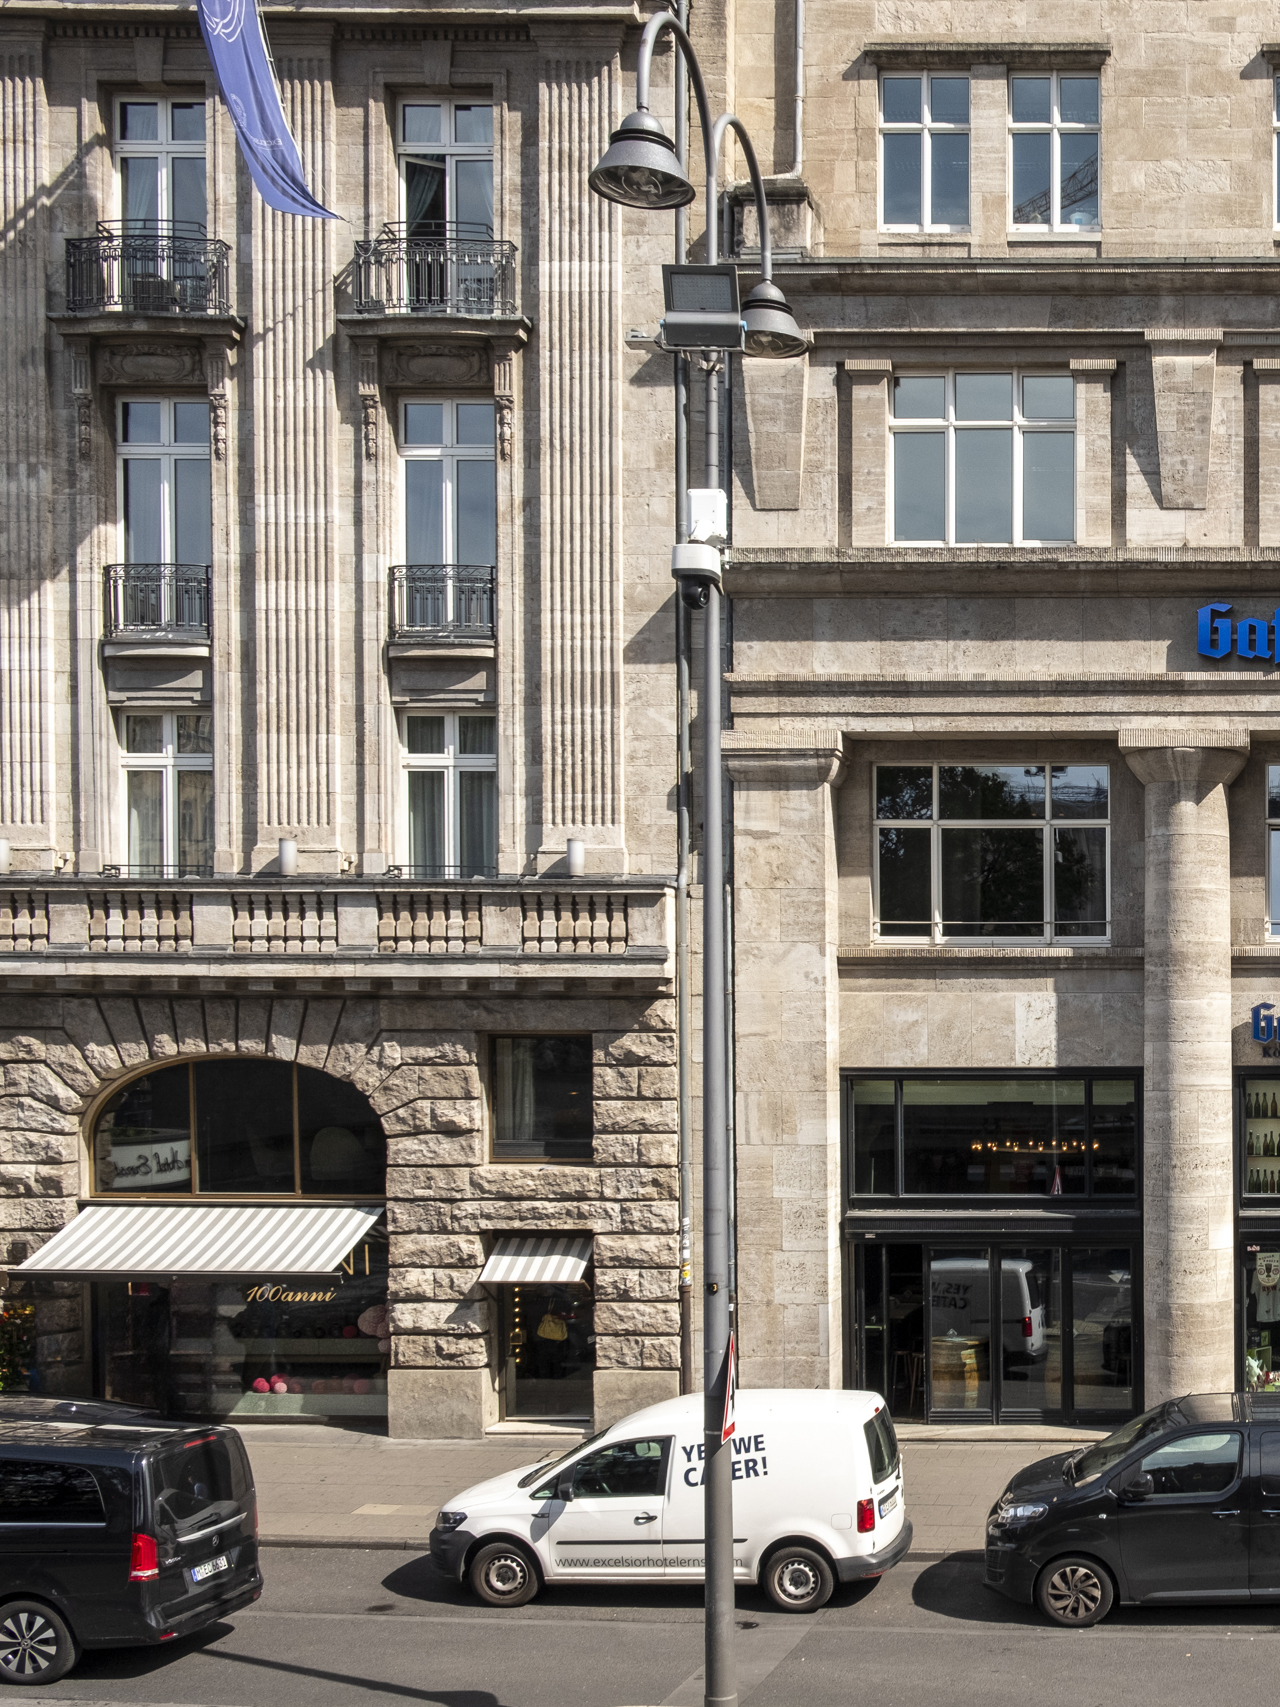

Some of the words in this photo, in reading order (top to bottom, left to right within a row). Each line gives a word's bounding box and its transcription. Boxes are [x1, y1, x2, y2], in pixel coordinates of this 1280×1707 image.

[246, 1285, 337, 1302] 100anni
[731, 1434, 765, 1455] WE
[684, 1456, 768, 1487] CER!
[555, 1555, 743, 1568] www.excelsiorhotelernsm
